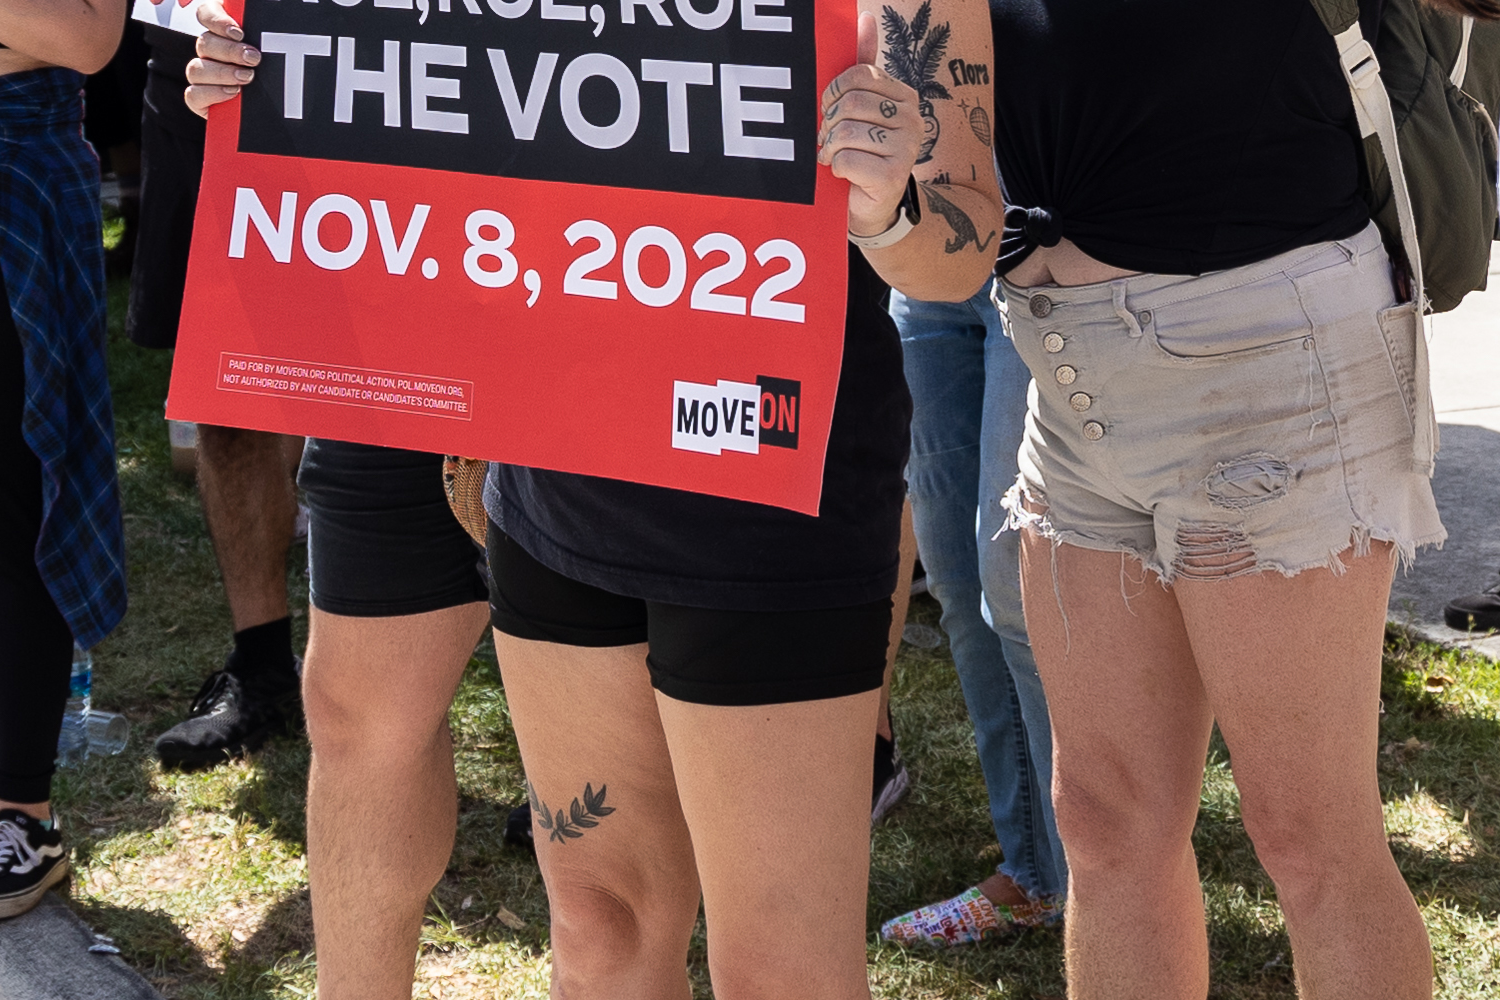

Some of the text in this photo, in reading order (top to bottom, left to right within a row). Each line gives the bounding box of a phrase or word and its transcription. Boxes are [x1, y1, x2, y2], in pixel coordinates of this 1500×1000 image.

[947, 58, 990, 87] Flora
[260, 31, 795, 162] THE VOTE
[227, 187, 807, 324] NOV. 8, 2022
[223, 373, 240, 384] NOT
[241, 375, 289, 391] AUTHORIZED
[290, 380, 301, 391] BY
[301, 382, 318, 394] ANY
[318, 384, 361, 399] CANDIDATE
[361, 388, 374, 400] OR
[373, 390, 423, 407] CANDIDATE'S
[228, 359, 247, 370] PAID
[248, 361, 263, 372] FOR
[264, 363, 275, 374] BY
[276, 365, 326, 381] MOVEON.ORG
[326, 372, 364, 386] POLITICAL
[366, 377, 397, 390] ACTION,
